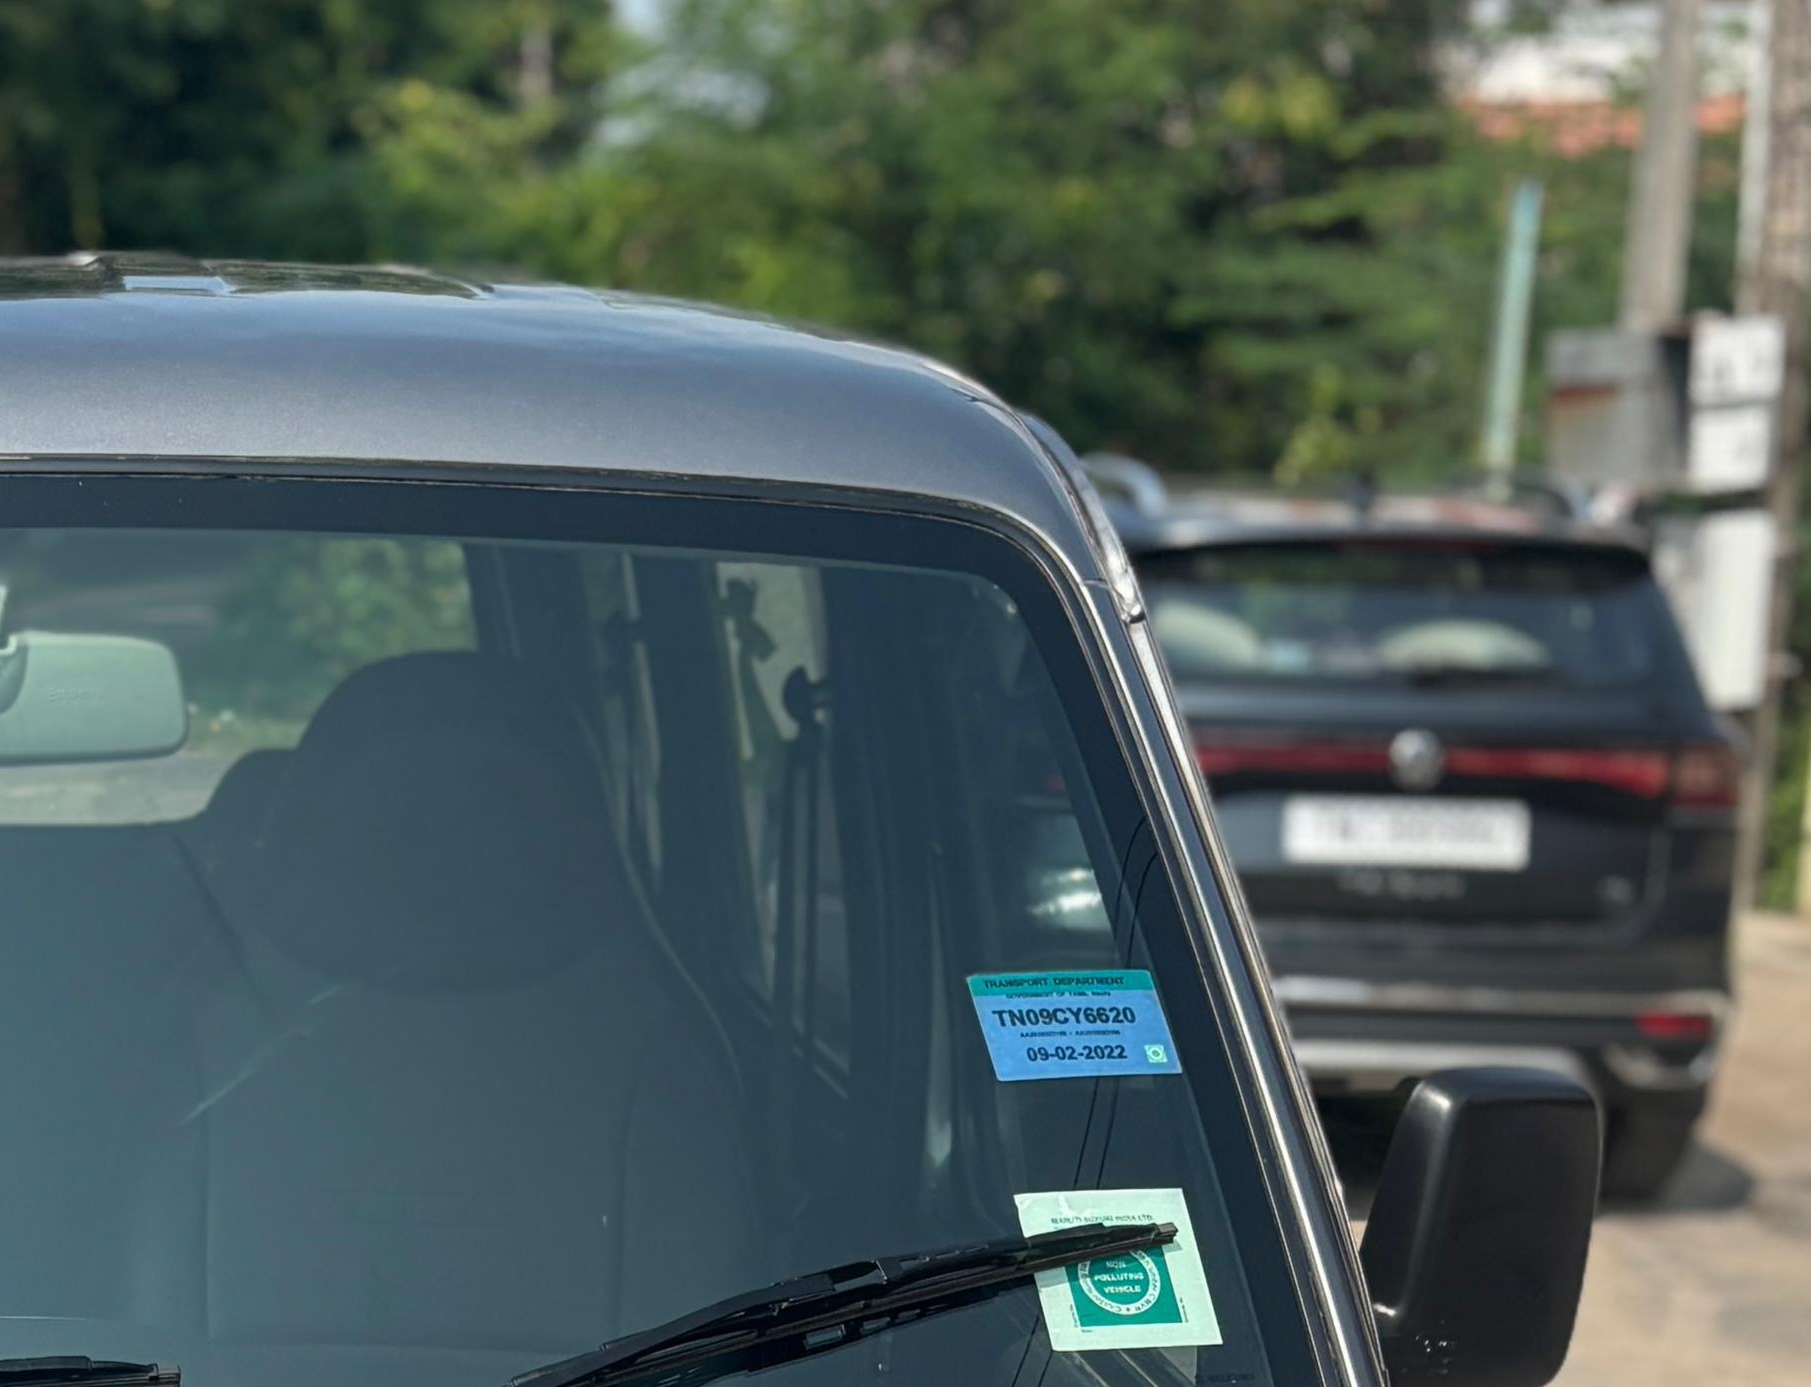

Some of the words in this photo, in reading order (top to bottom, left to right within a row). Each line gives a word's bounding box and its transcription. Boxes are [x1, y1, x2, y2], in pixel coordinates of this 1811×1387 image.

[983, 977, 1049, 989] TRANSPORT
[1052, 975, 1125, 986] DEPARTMENT
[991, 1006, 1137, 1027] TN09CY6620
[1026, 1044, 1129, 1062] 09-02-2022
[1094, 1272, 1145, 1282] POLLUTING
[1103, 1284, 1143, 1294] VEHICLE
